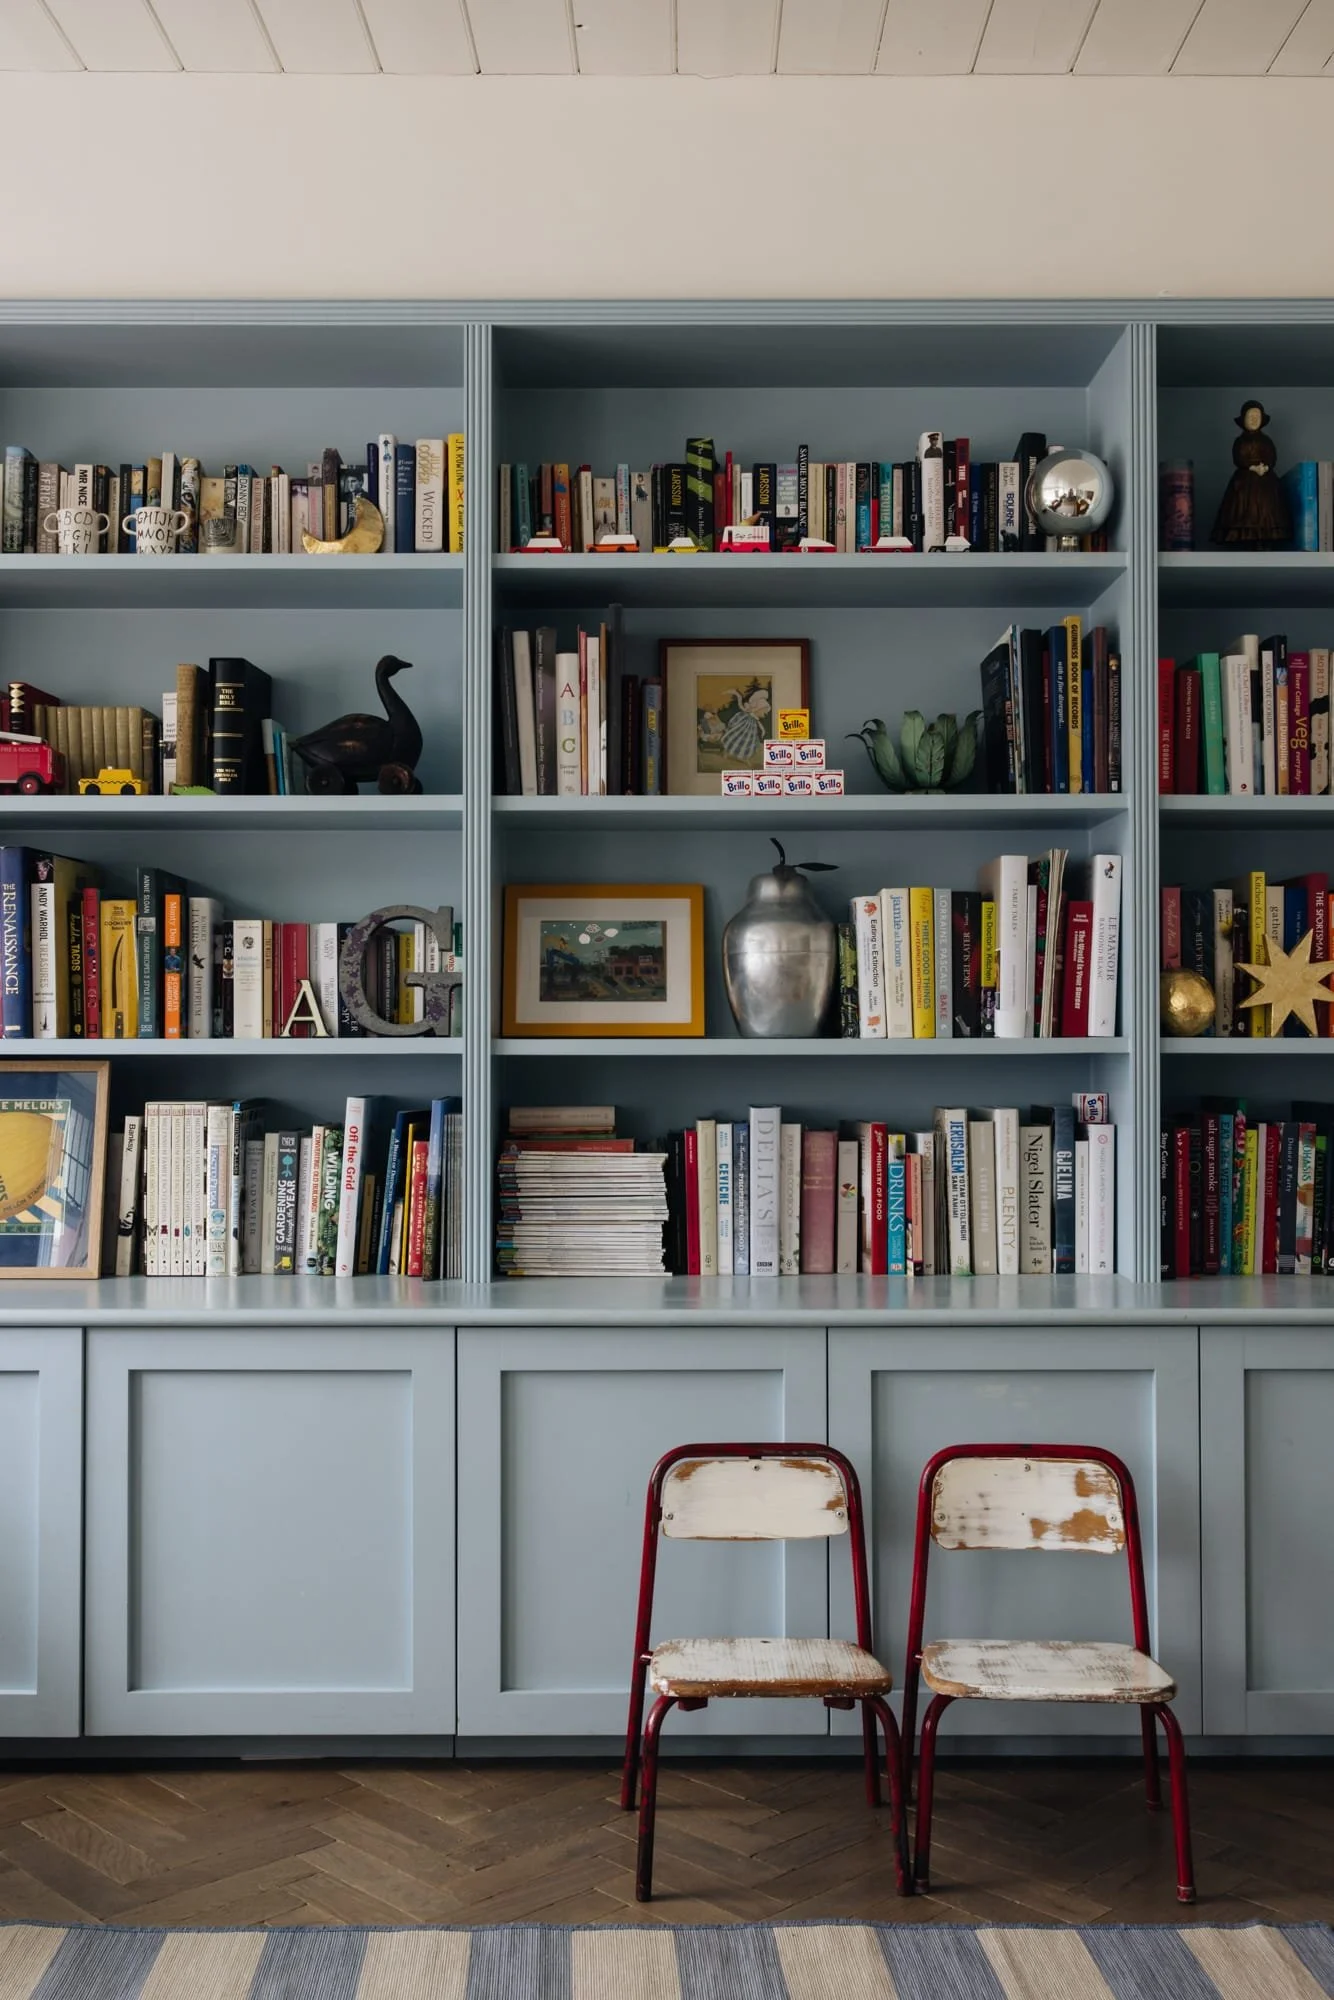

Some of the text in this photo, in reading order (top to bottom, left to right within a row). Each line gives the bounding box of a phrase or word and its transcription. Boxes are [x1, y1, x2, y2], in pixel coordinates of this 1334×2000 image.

[78, 469, 88, 506] MR NICE
[239, 478, 247, 506] DANNY
[671, 468, 681, 507] LARSSON
[760, 467, 770, 505] LARSSON
[799, 448, 807, 527] SAVOIE MONT BLANC
[422, 491, 435, 543] WICKED!
[1071, 624, 1079, 659] GUINNESS
[1071, 661, 1079, 682] BOOK
[1072, 684, 1079, 694] OF
[1316, 654, 1325, 694] MORITO
[559, 682, 574, 698] A
[561, 709, 574, 726] B
[782, 720, 804, 731] Brillo
[1279, 699, 1289, 771] Asian Dumplings
[1290, 716, 1308, 750] veg
[561, 737, 575, 753] C
[769, 749, 791, 761] Brillo
[800, 749, 822, 761] Brillo
[1162, 729, 1170, 780] THE COOKBOOK
[727, 781, 750, 793] Brillo
[758, 779, 780, 791] Brillo
[788, 780, 811, 791] Brillo
[819, 779, 841, 791] Brillo
[1255, 876, 1263, 908] Kitchen
[168, 901, 177, 925] Monty
[890, 895, 904, 930] jamie
[1270, 906, 1281, 941] gather
[1315, 890, 1324, 959] THE SPORTSMAN
[3, 891, 18, 995] RENAISSANCE
[39, 887, 49, 989] ANDY WARHOL TREASURES
[894, 940, 903, 967] home
[1077, 943, 1085, 963] World
[1078, 930, 1086, 942] The
[1106, 917, 1117, 981] LE MANOIR
[340, 904, 463, 1037] G
[922, 920, 931, 1010] THREE GOOD THINGS
[939, 895, 948, 1020] LORRAINE PASCALE BAKE
[194, 976, 203, 1016] IMPERIUM
[1075, 971, 1083, 986] Your
[279, 978, 334, 1037] A
[14, 1101, 64, 1111] MELONS
[1087, 1098, 1098, 1121] Brillo
[126, 1123, 136, 1152] Banksy
[950, 1120, 965, 1174] JERUSALEM
[1160, 1132, 1168, 1150] Stay
[1205, 1119, 1218, 1192] salt sugar smoke
[345, 1125, 359, 1191] Off the Grid
[757, 1119, 774, 1221] DELIA'S
[1056, 1151, 1072, 1200] GJELINA
[323, 1151, 339, 1210] WILDING
[718, 1163, 729, 1205] CEVICHE
[876, 1187, 882, 1197] OF
[889, 1165, 905, 1232] DRINKS
[1024, 1133, 1045, 1228] Nigel Slater
[276, 1180, 287, 1244] GARDENING
[286, 1180, 295, 1209] YEAR
[1002, 1186, 1016, 1249] PLENTY
